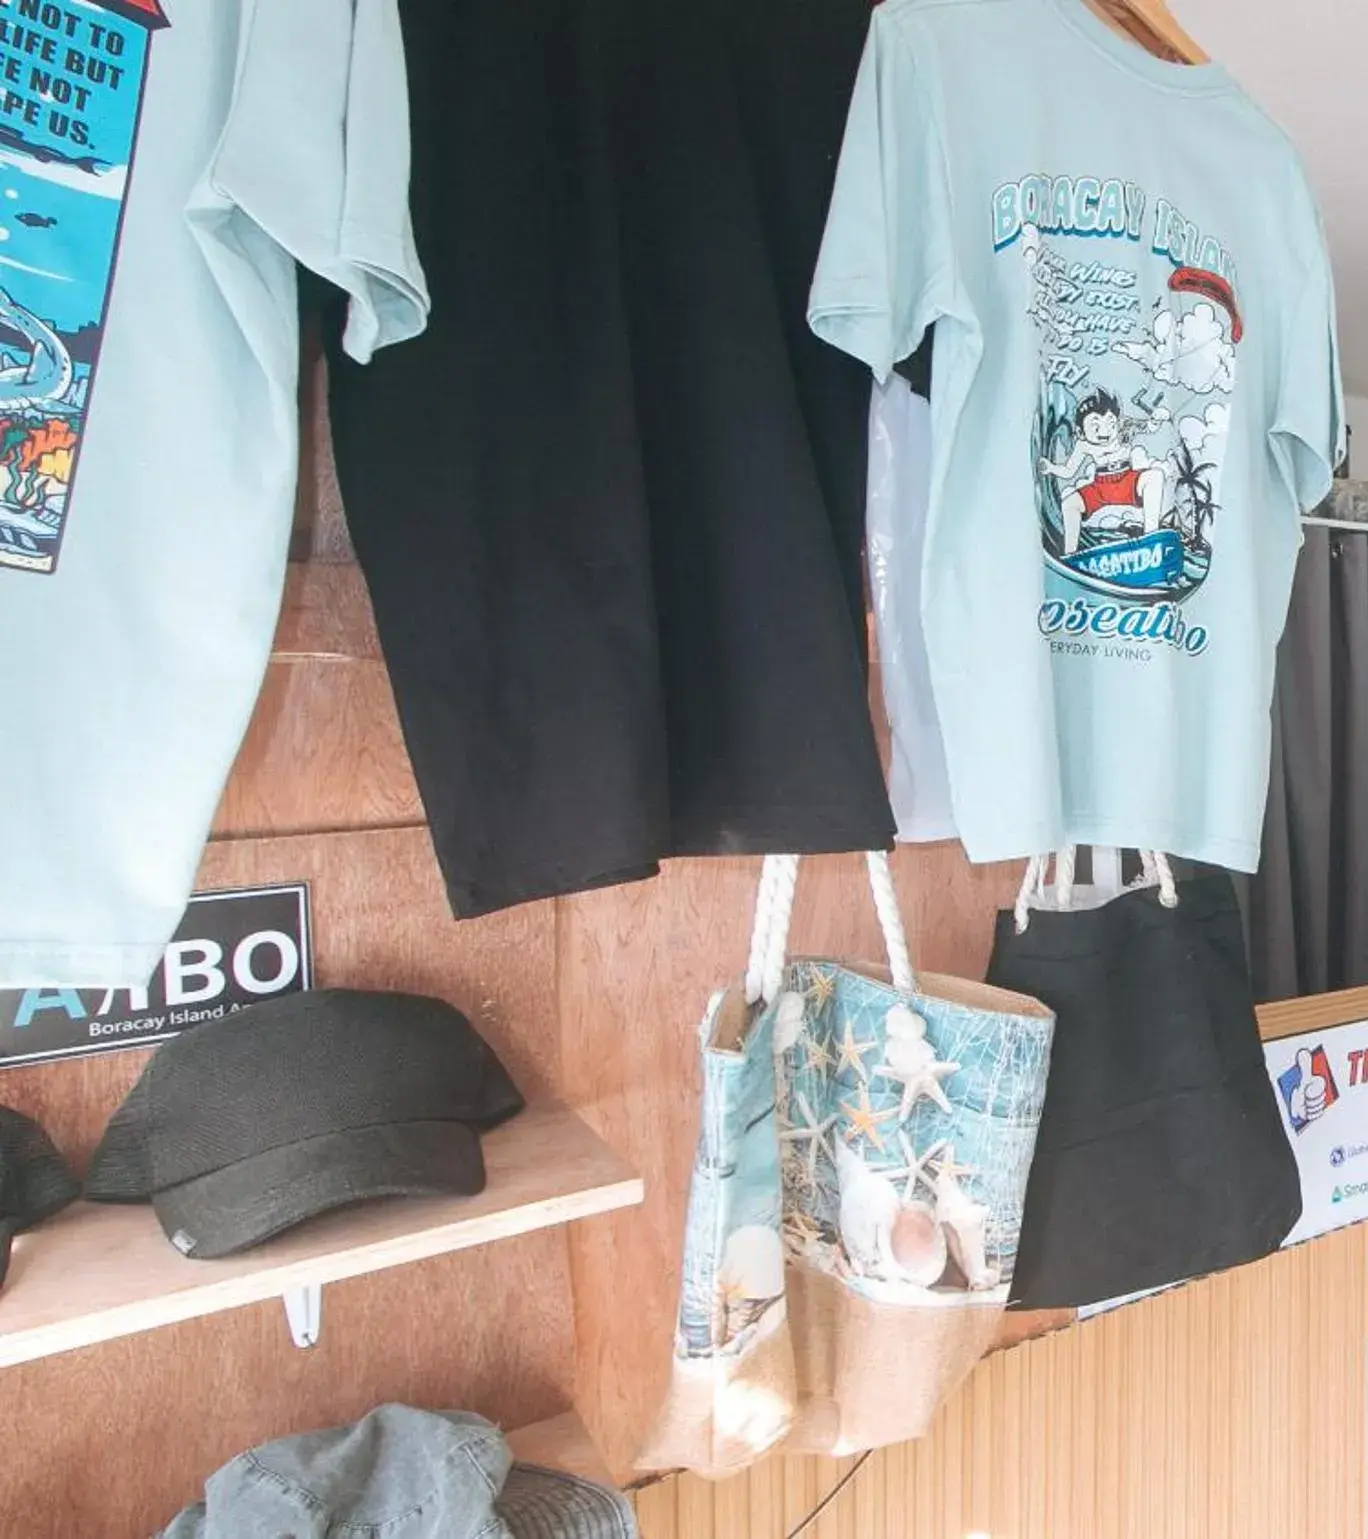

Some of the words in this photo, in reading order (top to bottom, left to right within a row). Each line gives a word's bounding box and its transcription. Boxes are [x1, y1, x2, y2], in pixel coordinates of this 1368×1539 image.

[17, 0, 82, 38] NOT
[89, 22, 126, 57] TO
[29, 67, 93, 113] NOT
[64, 47, 126, 91] BUT
[48, 109, 96, 151] US.
[89, 1013, 166, 1037] Boracay
[169, 1003, 225, 1026] Island
